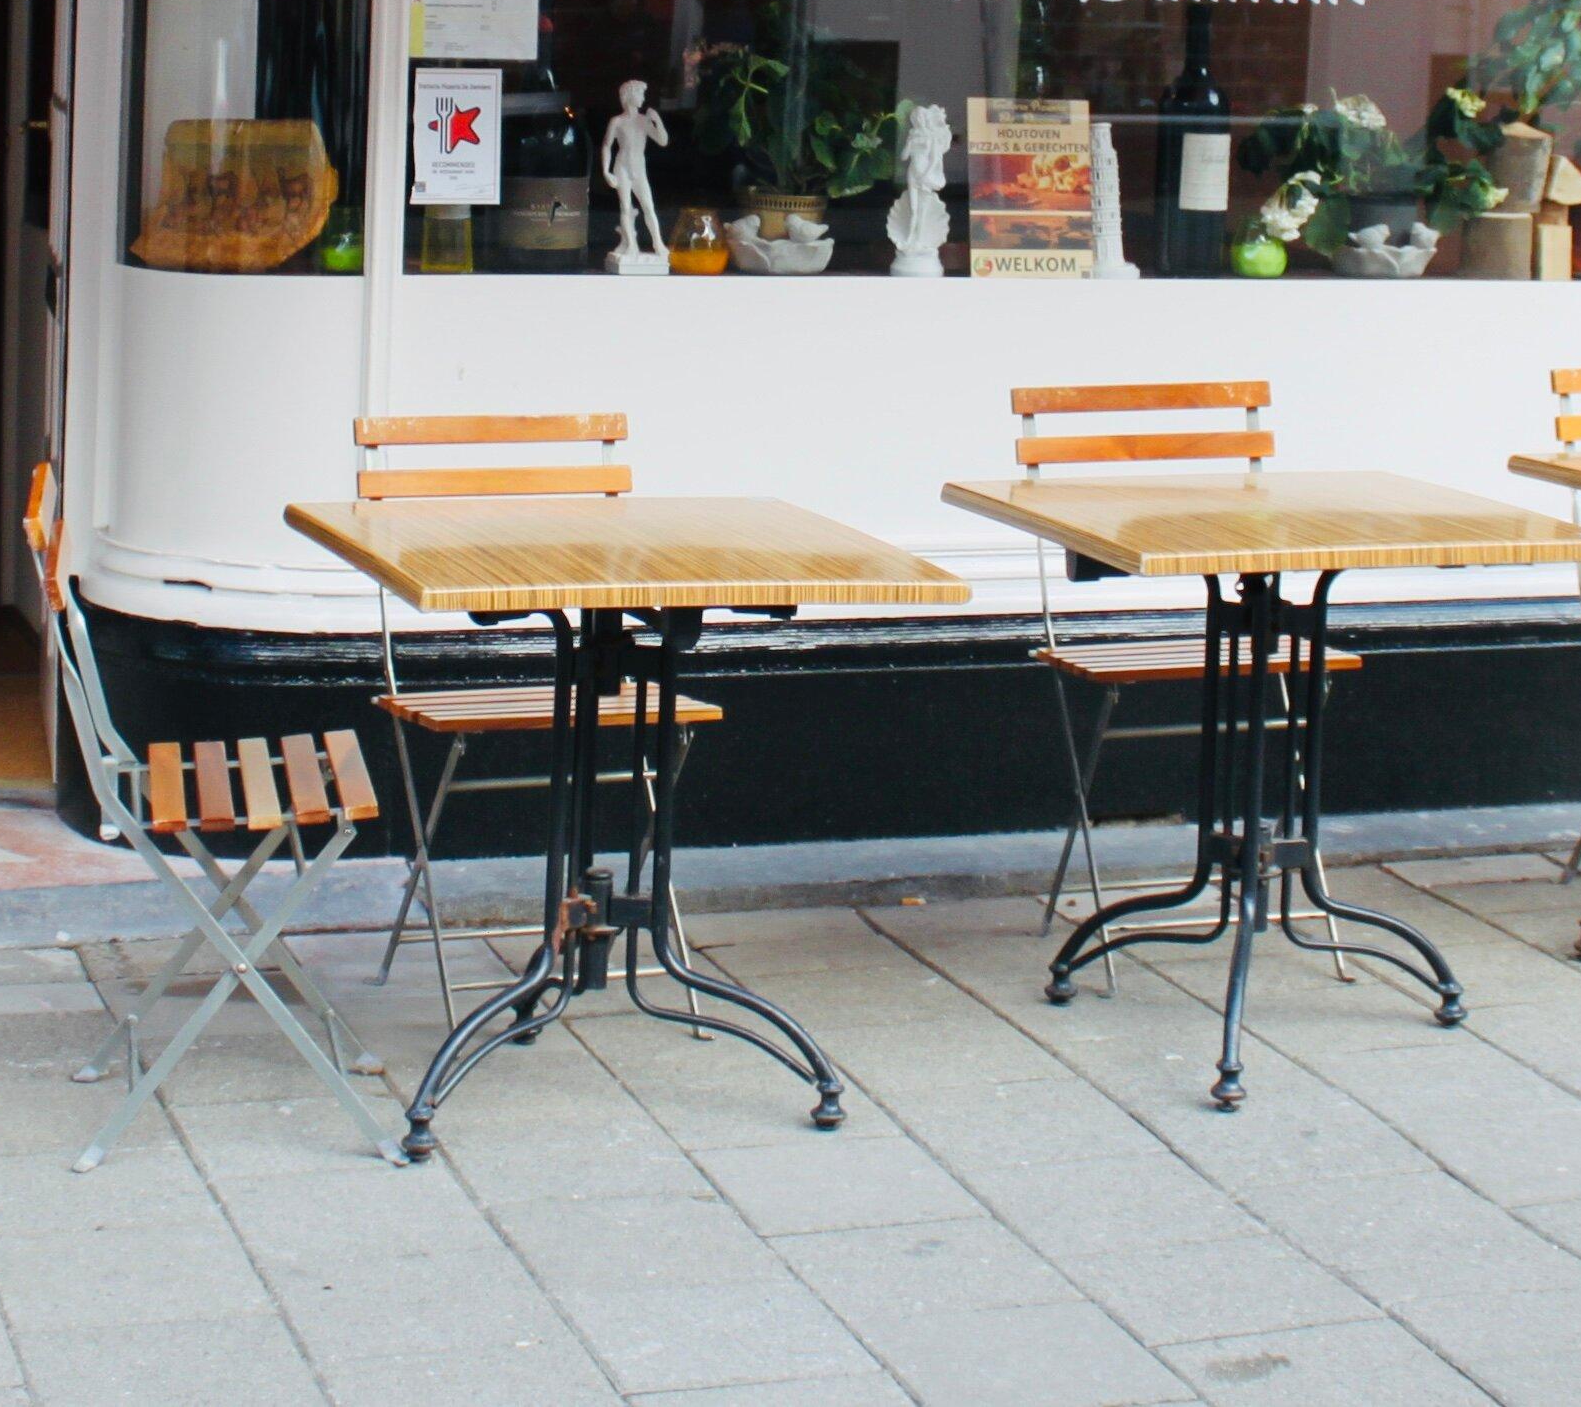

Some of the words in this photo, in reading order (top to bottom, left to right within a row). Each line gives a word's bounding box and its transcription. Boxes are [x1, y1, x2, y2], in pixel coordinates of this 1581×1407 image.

[998, 128, 1061, 140] HOUTOVEN
[1024, 142, 1089, 154] GERECHTEN
[995, 256, 1077, 273] WELKOM
